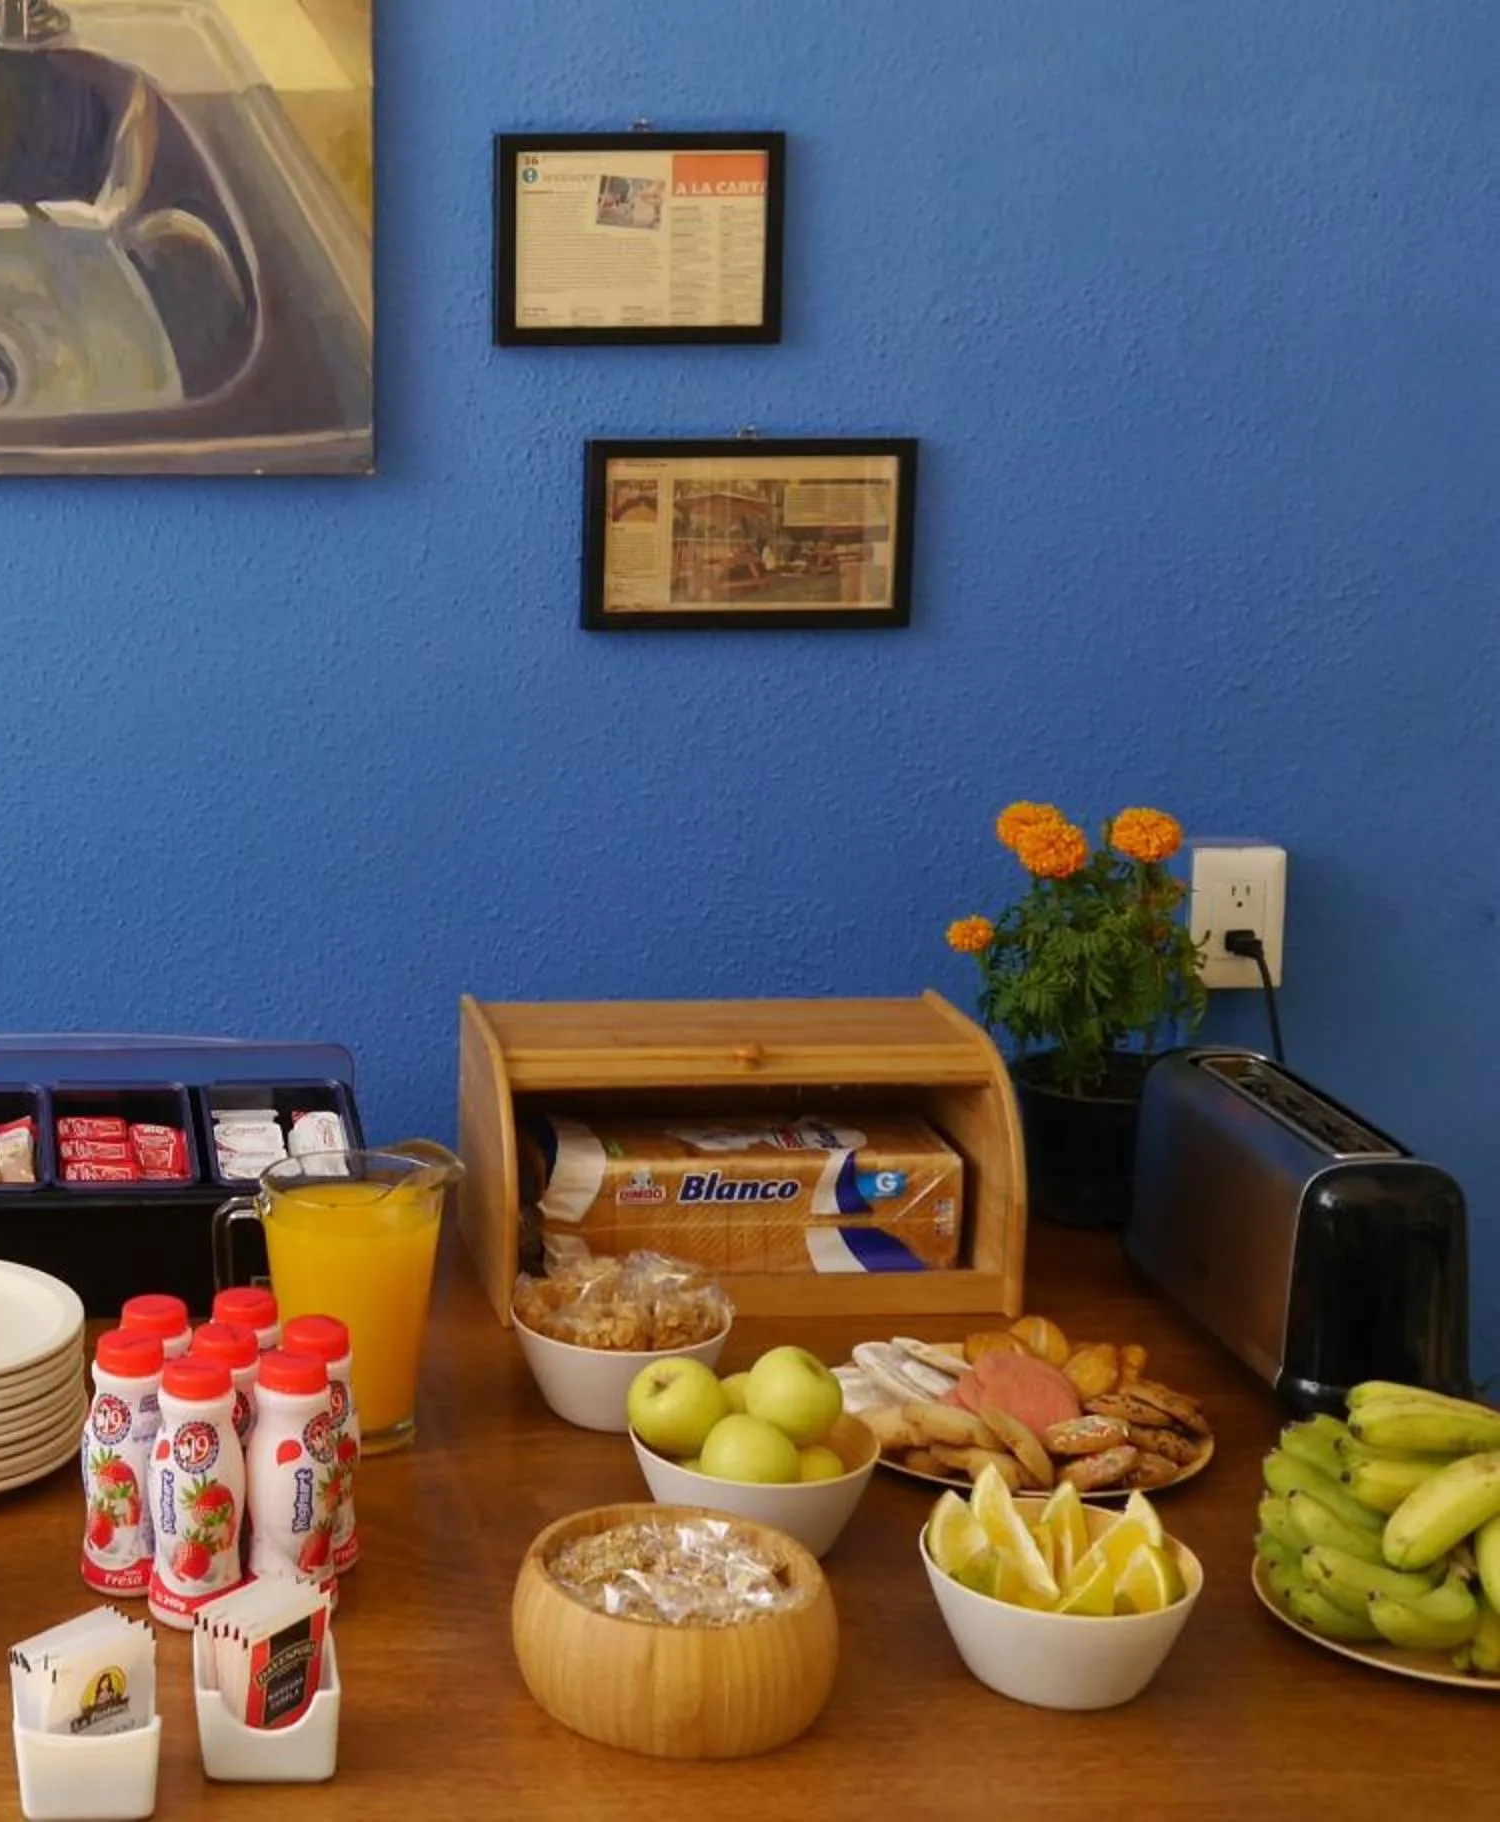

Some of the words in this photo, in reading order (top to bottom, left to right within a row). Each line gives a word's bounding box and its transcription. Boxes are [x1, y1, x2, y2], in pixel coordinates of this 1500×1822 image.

[675, 181, 687, 195] A
[691, 181, 712, 194] LA
[678, 1170, 800, 1202] Blanco
[875, 1172, 897, 1192] G
[292, 1468, 312, 1533] Yoghurt
